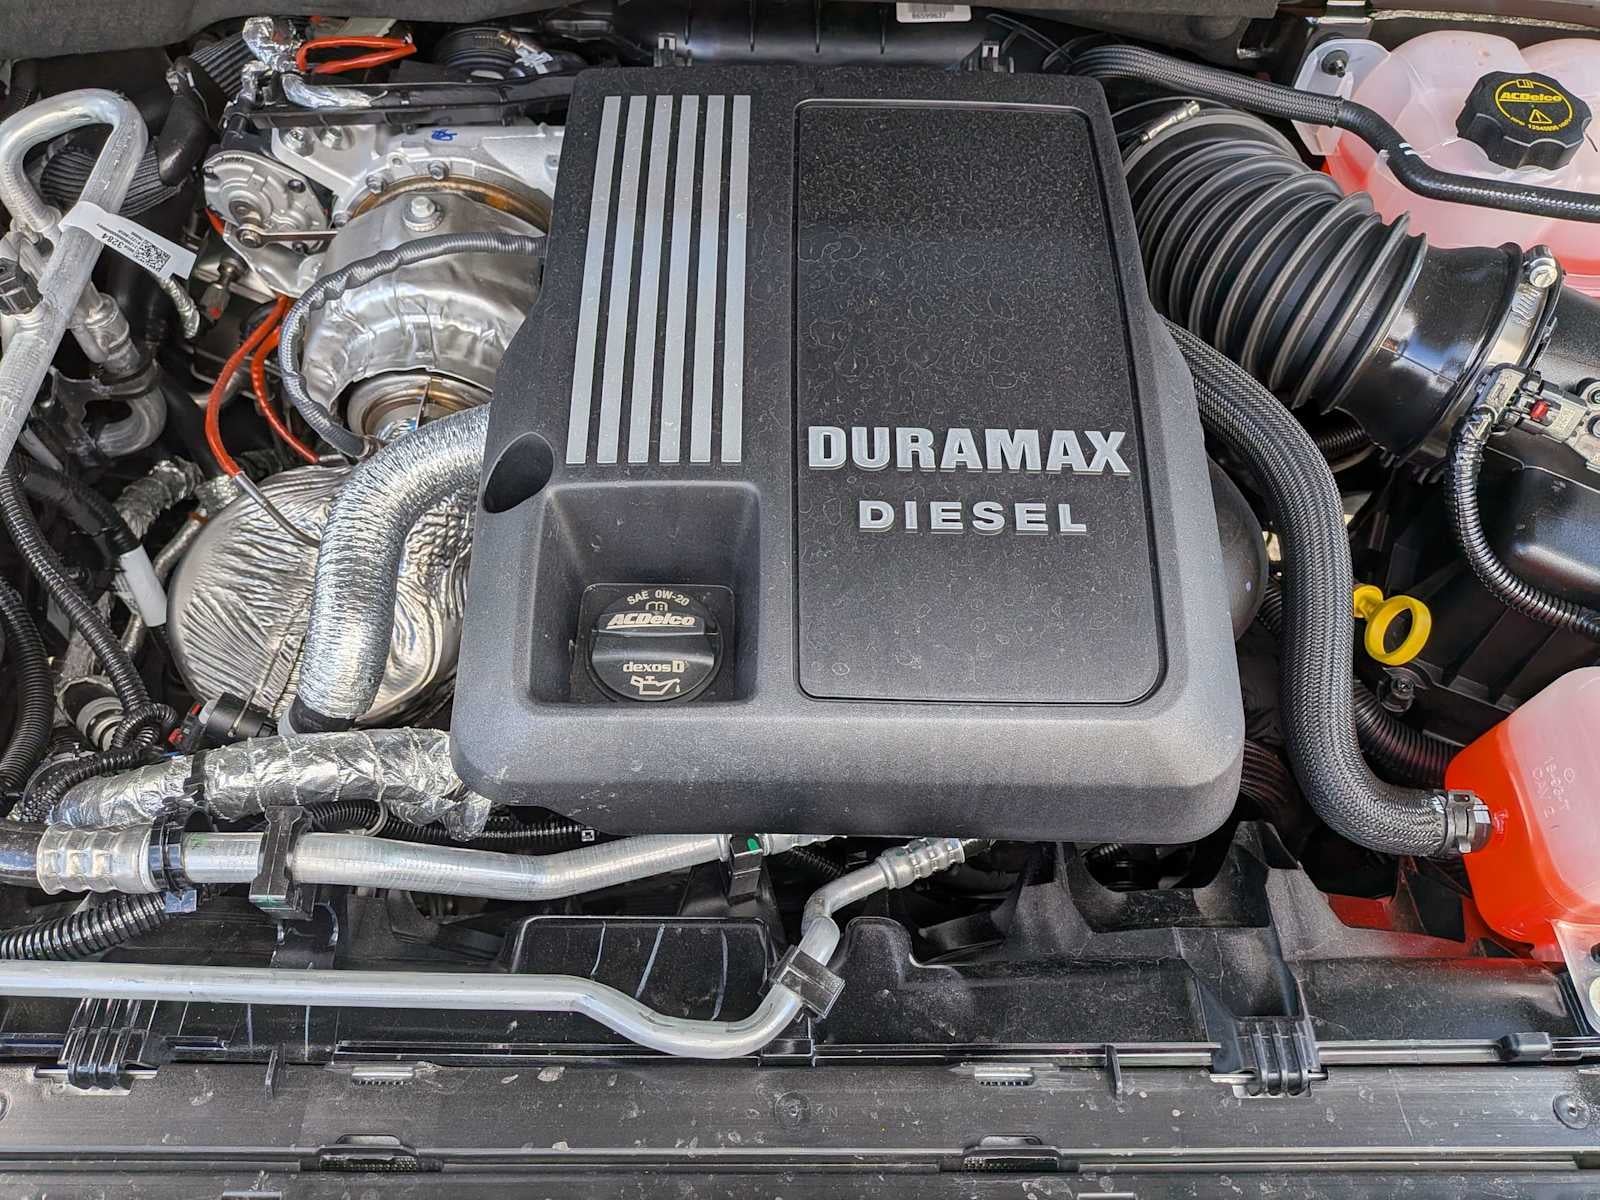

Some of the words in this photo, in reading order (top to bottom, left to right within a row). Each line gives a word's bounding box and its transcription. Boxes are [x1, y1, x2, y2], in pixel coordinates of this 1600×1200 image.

[1499, 92, 1562, 103] ACDelco
[101, 232, 125, 249] 3284
[808, 425, 1132, 475] DURAMAX
[858, 500, 1087, 535] DIESEL
[626, 590, 650, 605] SAE
[655, 589, 690, 606] 0W-20
[606, 612, 696, 630] ACDelco
